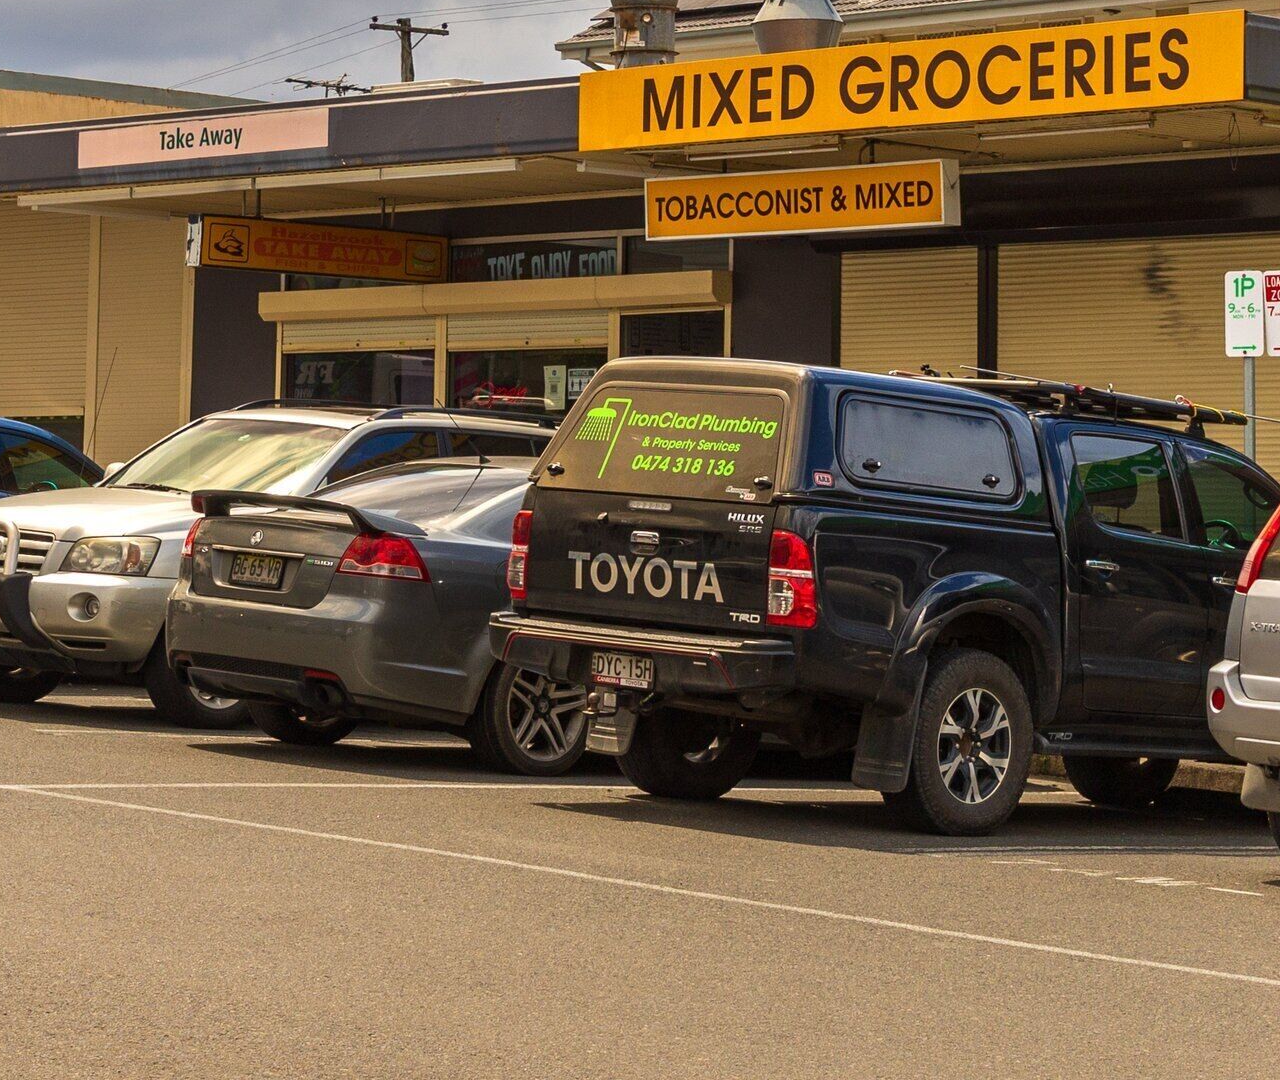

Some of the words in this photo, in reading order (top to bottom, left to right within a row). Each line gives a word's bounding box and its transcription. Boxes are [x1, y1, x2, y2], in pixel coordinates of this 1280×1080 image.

[642, 64, 815, 133] MIXED
[839, 27, 1190, 115] GROCERIES
[159, 128, 195, 151] Take
[199, 127, 243, 149] Away
[655, 186, 824, 222] TOBACCONIST
[831, 185, 848, 212] &
[855, 180, 934, 210] MIXED
[262, 238, 320, 258] TAKE
[331, 245, 394, 265] AWAY
[1233, 277, 1255, 297] 1P
[627, 410, 699, 430] IronClad
[699, 412, 777, 439] Plumbing
[642, 436, 650, 447] &
[652, 437, 696, 452] Property
[697, 439, 741, 452] Services
[631, 455, 670, 471] 0474
[672, 457, 704, 474] 318
[706, 458, 735, 476] 136
[728, 512, 765, 524] HILUX
[568, 551, 724, 603] TOYOTA
[729, 612, 761, 624] TRD
